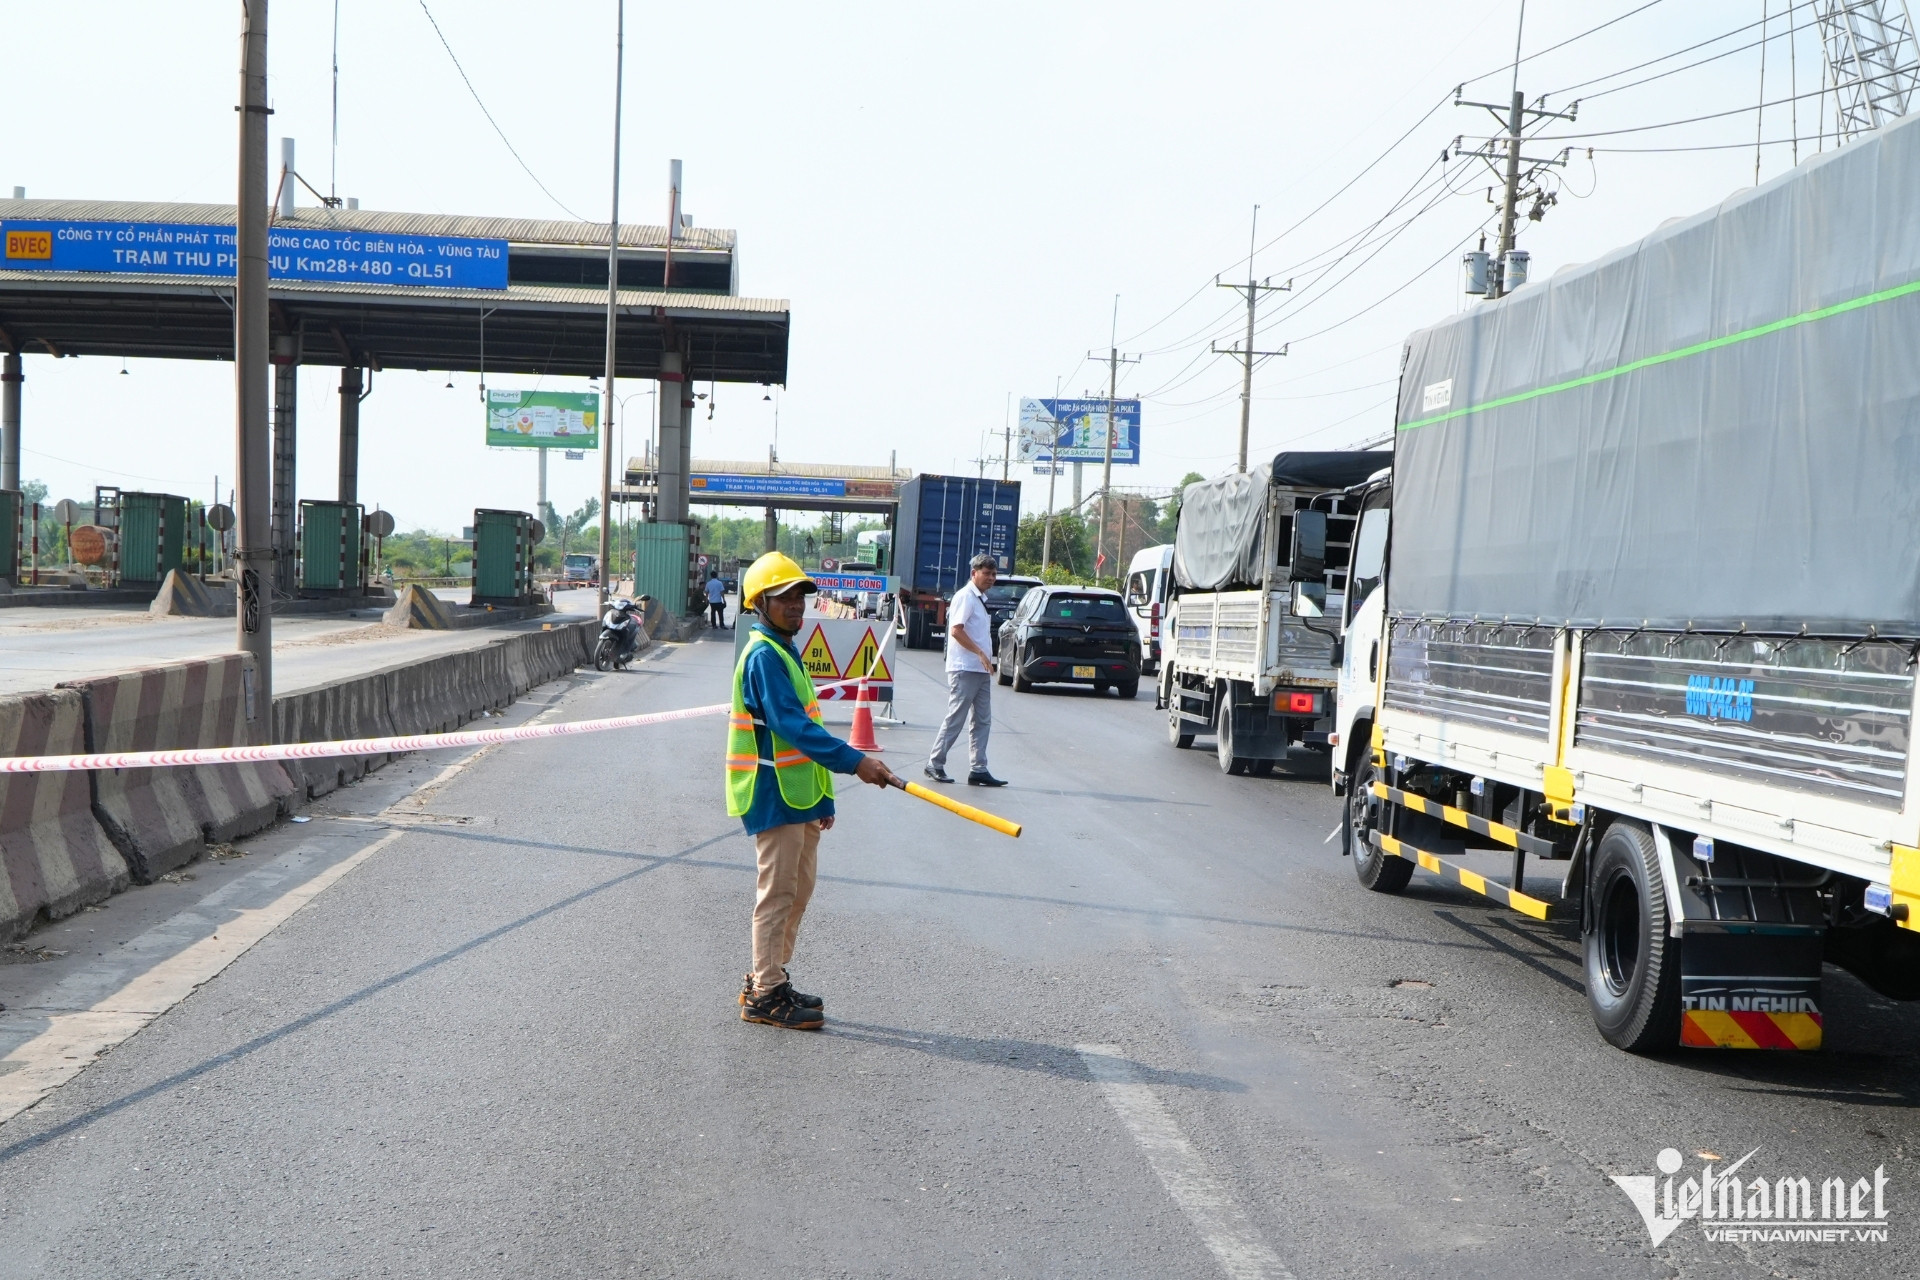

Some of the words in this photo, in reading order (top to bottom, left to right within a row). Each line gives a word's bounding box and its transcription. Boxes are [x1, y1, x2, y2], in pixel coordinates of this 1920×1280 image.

[9, 237, 48, 254] BVEC
[57, 227, 93, 241] CÔNG
[96, 230, 112, 241] TY
[116, 225, 135, 242] CỔ
[138, 227, 173, 243] PHẦN
[176, 229, 210, 245] PHÁT
[214, 234, 238, 246] TRI
[268, 233, 300, 248] ỜNG
[303, 238, 330, 250] CAO
[334, 236, 361, 252] TỐC
[365, 240, 394, 254] BIÊN
[397, 240, 425, 255] HÒA
[438, 242, 473, 258] VŨNG
[476, 243, 500, 259] TÀU
[113, 249, 167, 267] TRẠM
[174, 251, 211, 267] THU
[217, 253, 238, 268] PH
[268, 255, 290, 274] HỤ
[296, 256, 392, 276] Km28+480
[408, 263, 453, 279] QL51
[815, 577, 839, 588] ĐANG
[841, 579, 856, 589] THI
[858, 576, 882, 590] CÔNG
[812, 648, 822, 658] ĐI
[1682, 996, 1726, 1011] TIN
